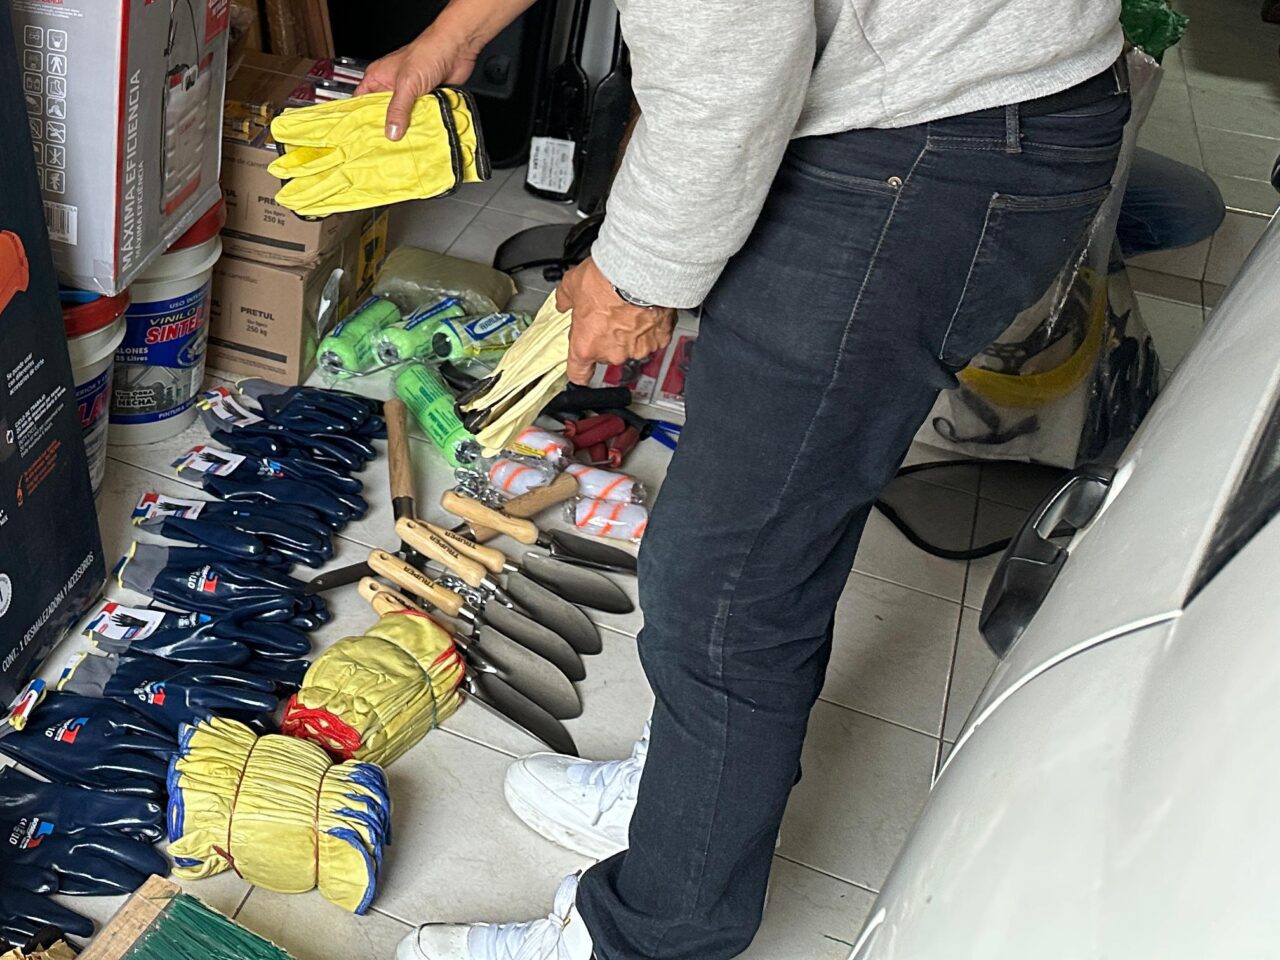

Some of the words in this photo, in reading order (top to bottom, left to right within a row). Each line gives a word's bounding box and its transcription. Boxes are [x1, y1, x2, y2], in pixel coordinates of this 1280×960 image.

[125, 68, 141, 185] EFICIENCIA
[263, 214, 276, 224] 250
[150, 307, 195, 325] VINILO
[240, 306, 275, 321] PRETUL
[429, 534, 460, 560] TRUPER
[445, 530, 477, 550] TRUPER
[403, 565, 436, 589] TRUPER
